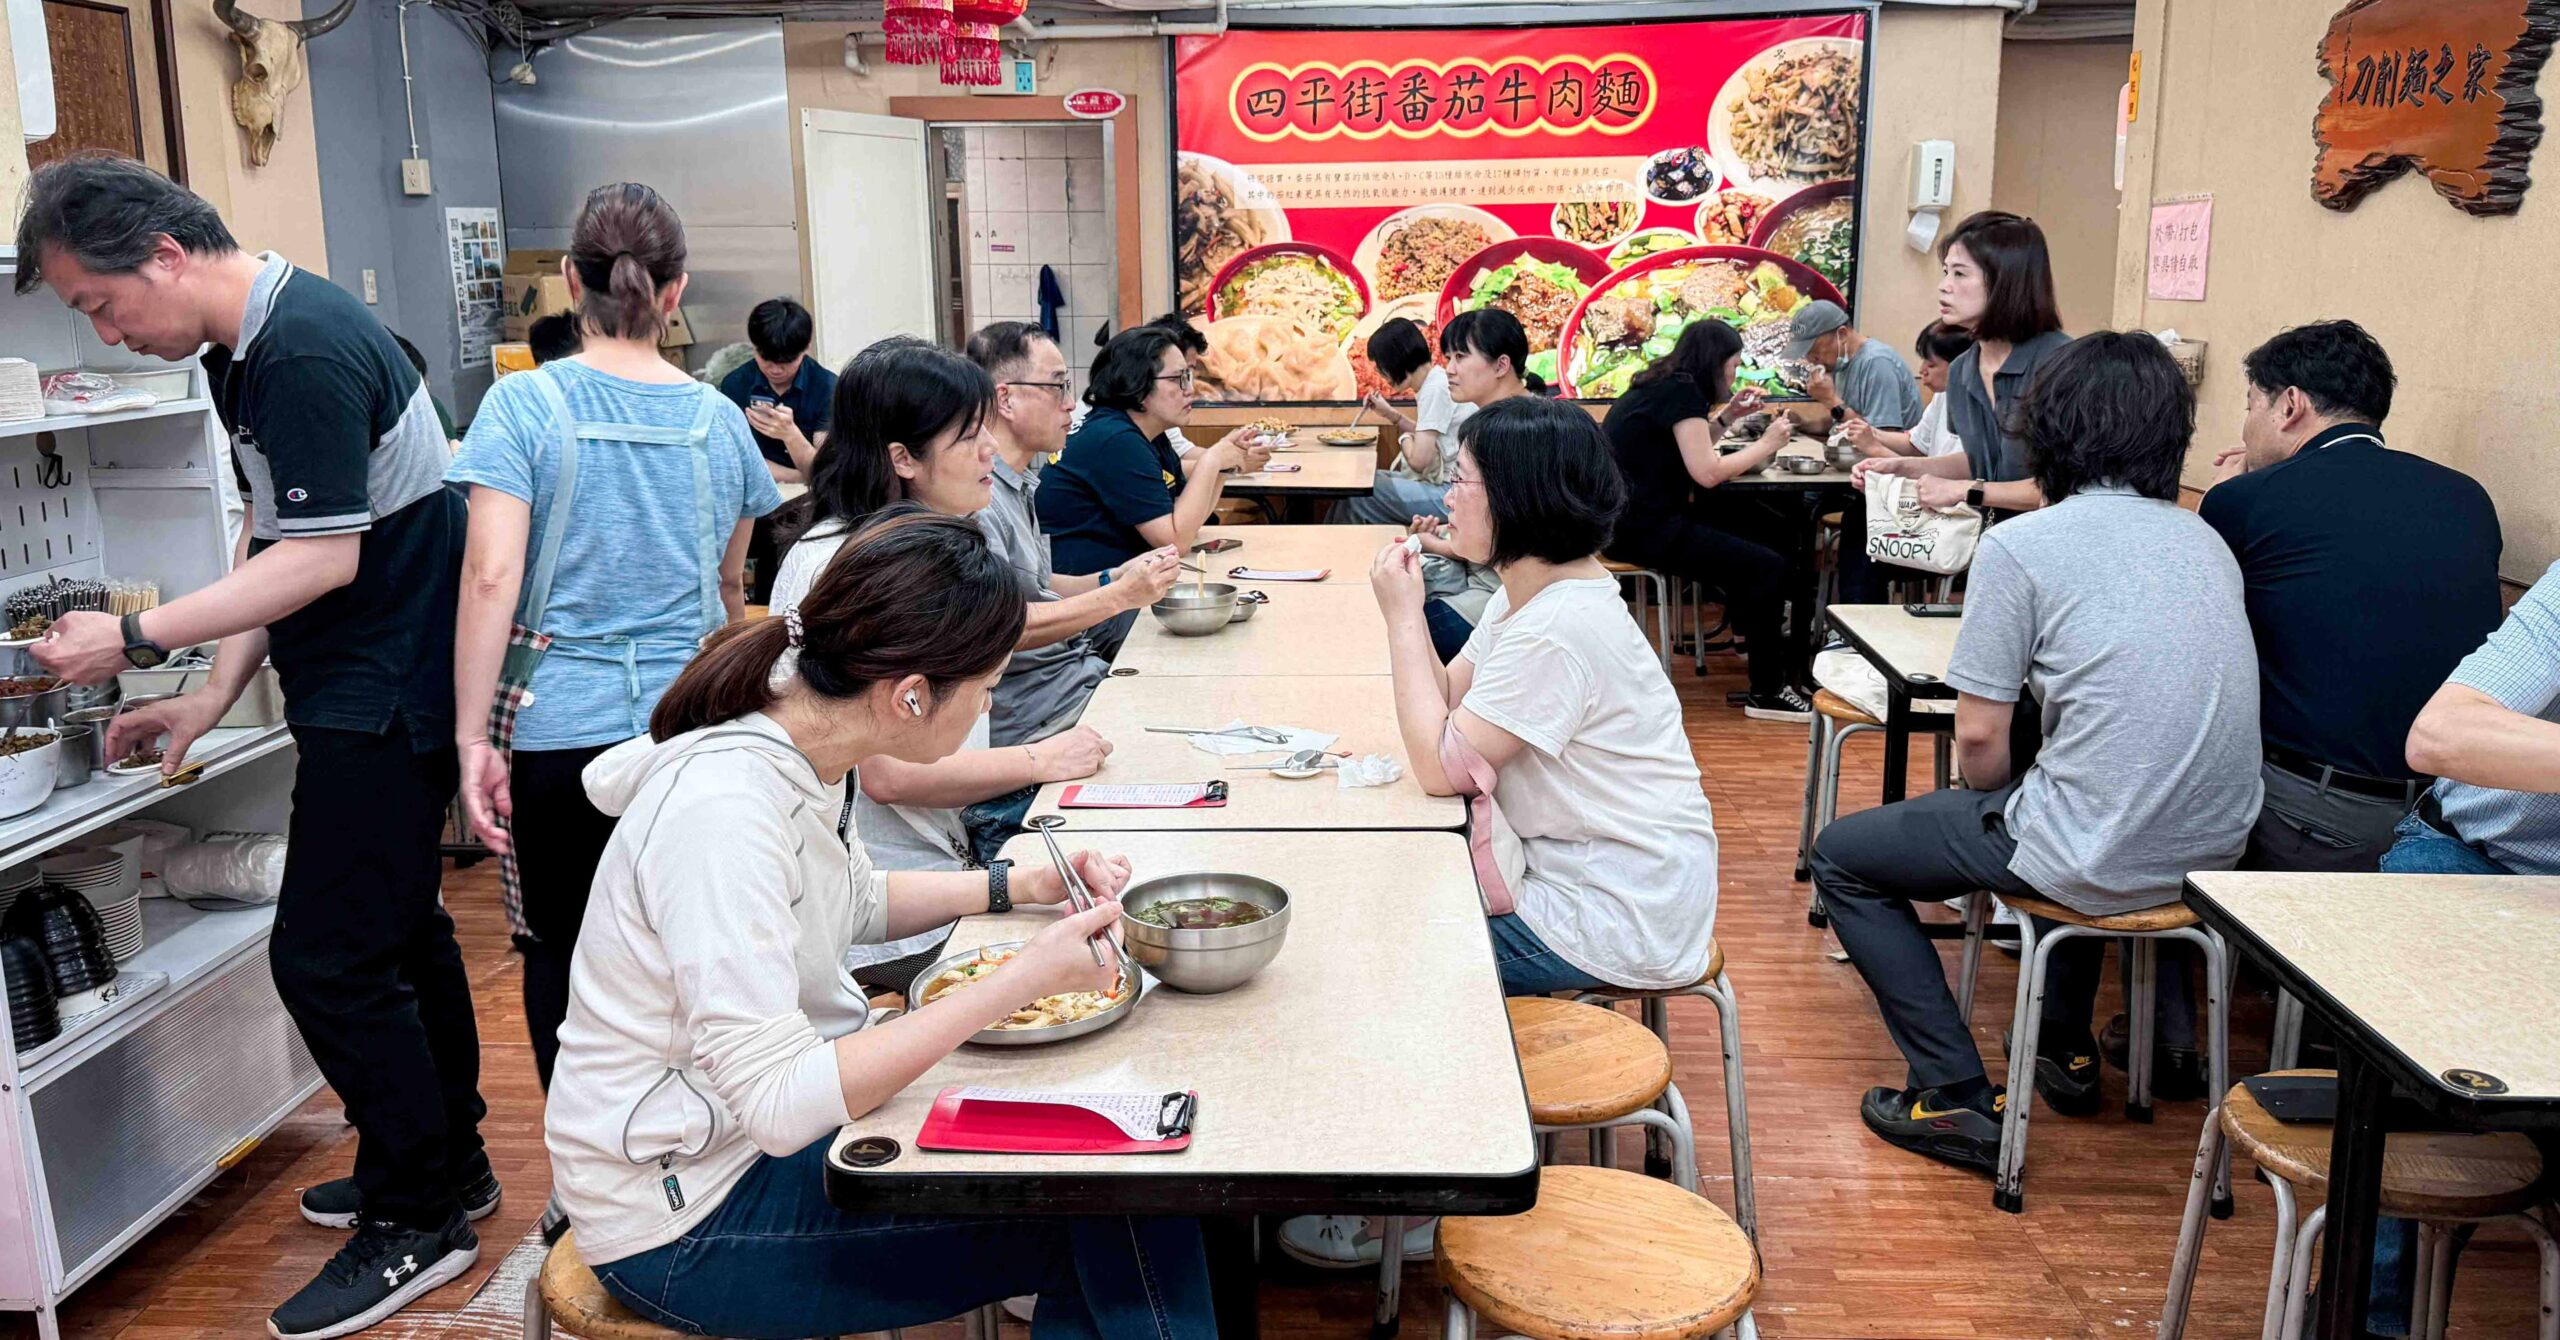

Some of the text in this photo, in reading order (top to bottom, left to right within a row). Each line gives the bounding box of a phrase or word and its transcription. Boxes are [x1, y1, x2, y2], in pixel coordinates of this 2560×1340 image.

[1246, 68, 1640, 126] 四平街番茄牛肉麵
[2348, 43, 2492, 107] 刀削麵之家
[1869, 537, 1935, 561] SNOOPY
